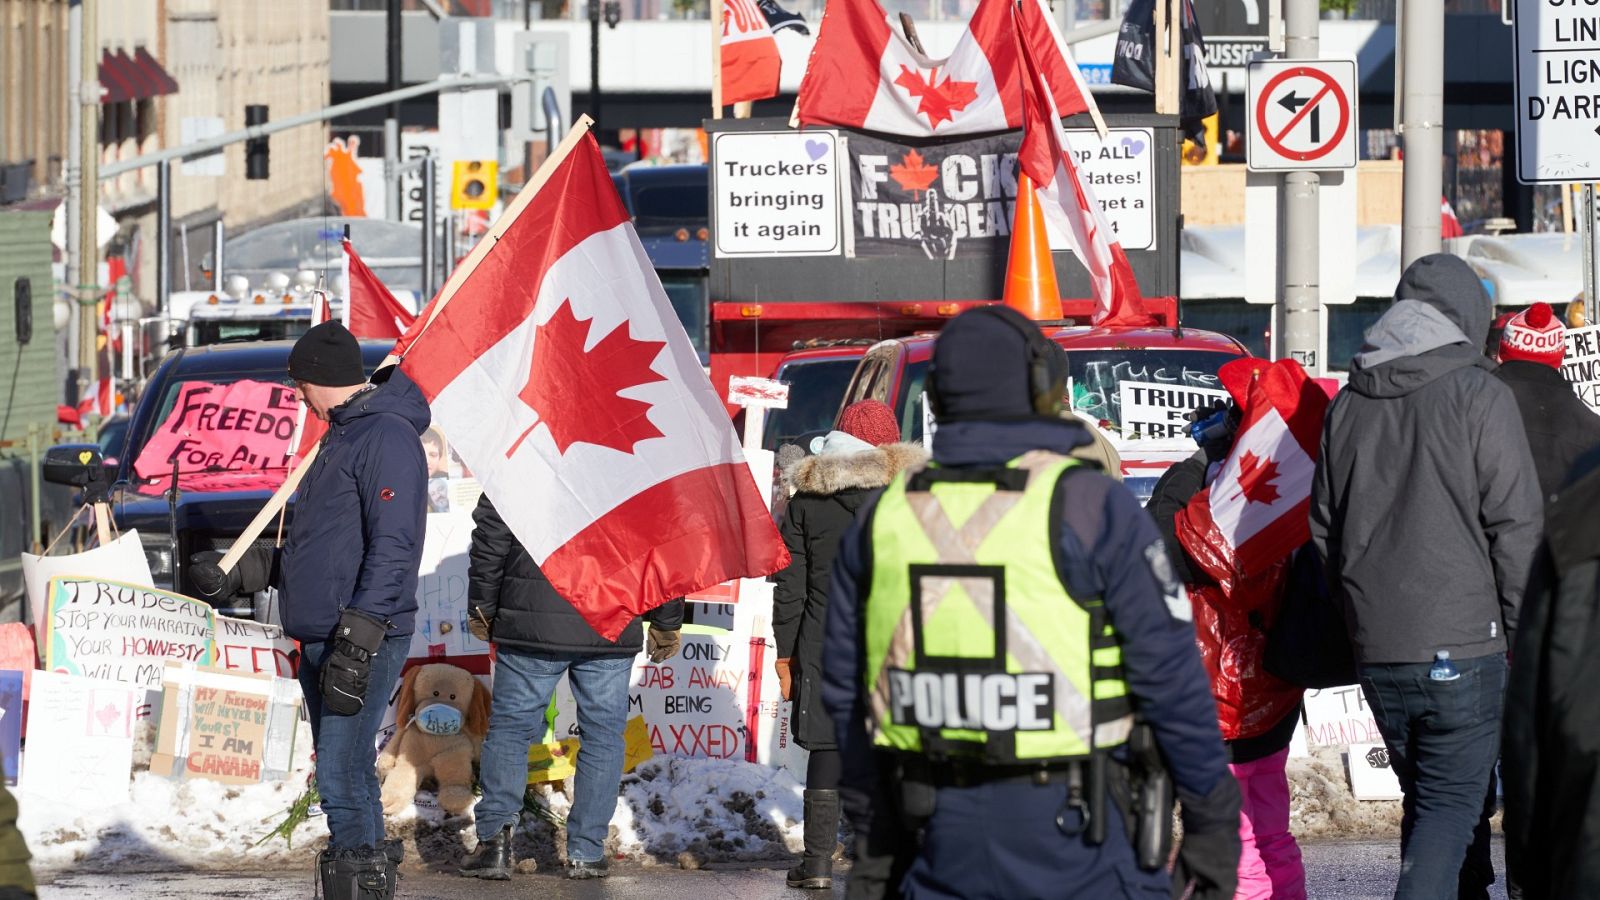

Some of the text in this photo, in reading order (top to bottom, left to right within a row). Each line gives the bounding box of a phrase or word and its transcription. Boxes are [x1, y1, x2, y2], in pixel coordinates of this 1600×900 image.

[1555, 17, 1600, 42] LIN
[1546, 59, 1600, 84] LIGN
[1099, 146, 1135, 160] ALL
[725, 160, 828, 176] Truckers
[1086, 171, 1141, 185] dates!
[730, 190, 823, 210] bringing
[1134, 199, 1144, 209] a
[734, 220, 821, 241] it again
[1513, 330, 1564, 349] TOQUE
[1564, 331, 1596, 360] E'RE
[170, 386, 295, 441] FREEDO
[54, 609, 215, 639] STOP YOUR NARRATIVE
[224, 621, 253, 637] ME
[70, 635, 205, 662] YOUR HONNESTY
[683, 643, 731, 662] ONLY
[638, 666, 744, 692] JAB AWAY
[195, 688, 217, 701] MY
[665, 695, 713, 715] BEING
[889, 671, 1051, 731] POLICE
[217, 704, 251, 722] NEVER
[779, 716, 789, 750] FATHER
[198, 734, 253, 755] I AM
[186, 751, 260, 780] CANADA
